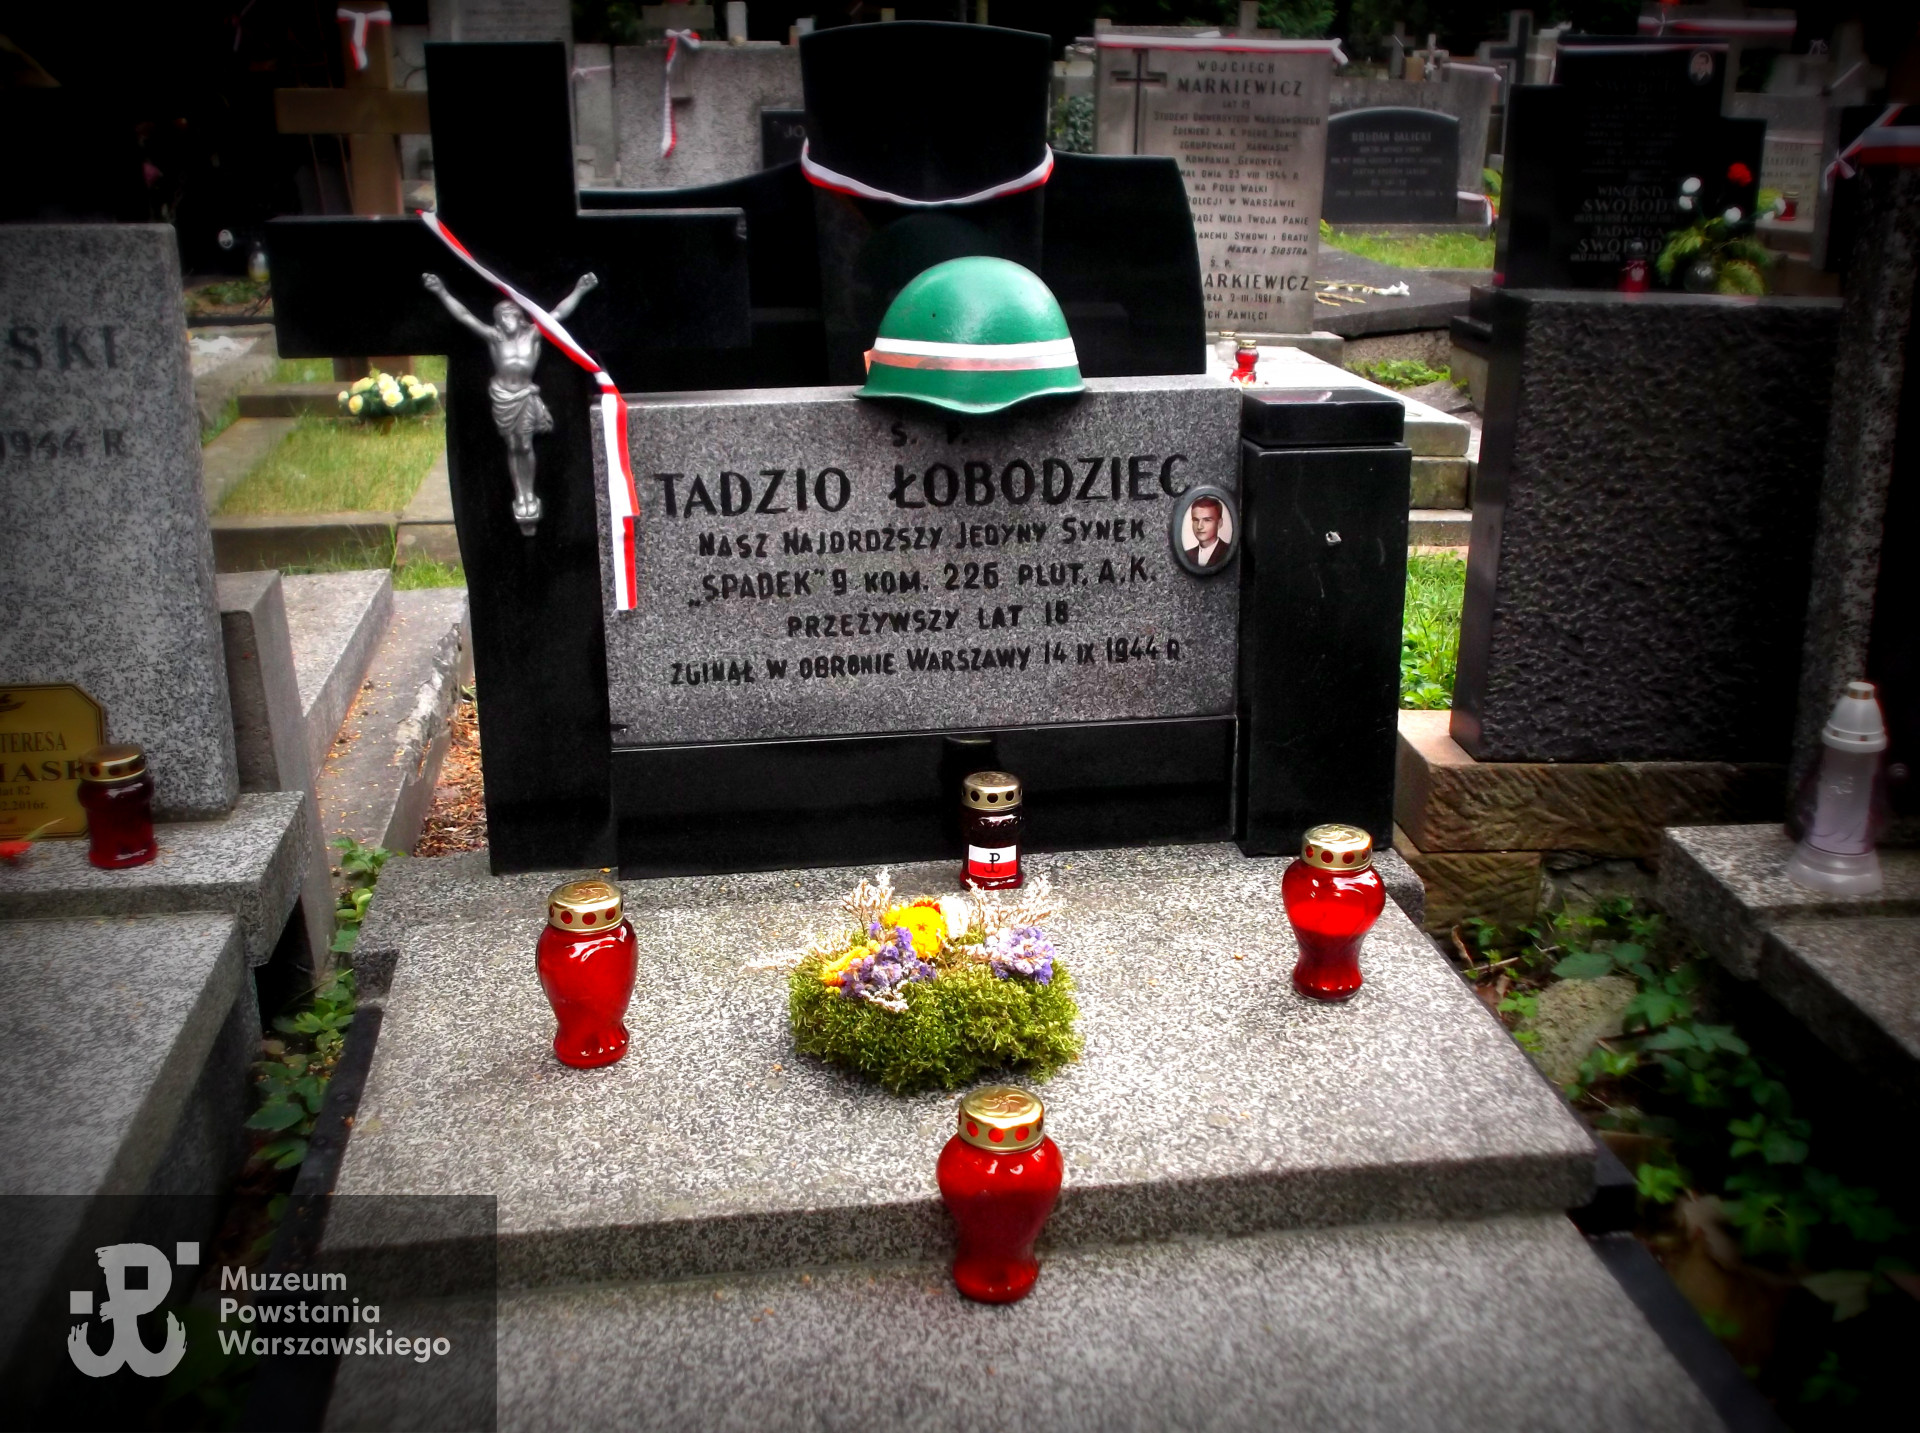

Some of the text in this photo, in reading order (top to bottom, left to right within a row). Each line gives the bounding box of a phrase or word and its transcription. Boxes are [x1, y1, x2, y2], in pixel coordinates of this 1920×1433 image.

[1197, 60, 1276, 73] WOJCIECH
[1177, 77, 1303, 97] MARKIEWICZ
[1186, 155, 1231, 166] KOMPANIA
[1201, 169, 1222, 178] DNIA
[1266, 170, 1287, 180] 1944
[1212, 182, 1236, 193] POLU
[1240, 183, 1268, 193] WALKI
[1242, 196, 1296, 208] WARSZAWIE
[1219, 213, 1243, 224] WOLA
[1247, 213, 1278, 225] TWOJA
[1282, 215, 1309, 226] PANIE
[1234, 231, 1268, 242] SYNOWI
[1281, 232, 1309, 242] BRATU
[1227, 244, 1258, 255] MATKA
[1270, 245, 1308, 256] SIOSTRA
[1203, 272, 1310, 291] ARKIEWICZ
[1228, 309, 1268, 322] PAMIĘCI
[654, 453, 1191, 519] TADZIO ŁOBODZIEC
[699, 516, 1146, 559] NASZ NAJDROŻSZY JEDYNY SYNEK
[831, 568, 848, 596] 9
[863, 570, 930, 595] KOM.
[944, 561, 999, 591] 226
[1018, 562, 1089, 587] PLUT.
[787, 599, 1069, 638] PRZEŻYWSZY LAT 18
[670, 660, 756, 686] ZGINĄŁ
[766, 658, 788, 680] W
[799, 652, 897, 679] OBRONIE
[906, 645, 1031, 672] WARSZAWY
[1043, 640, 1068, 665] 14
[1078, 642, 1096, 664] IX
[1105, 634, 1159, 664] 1944
[0, 731, 68, 753] TERESA
